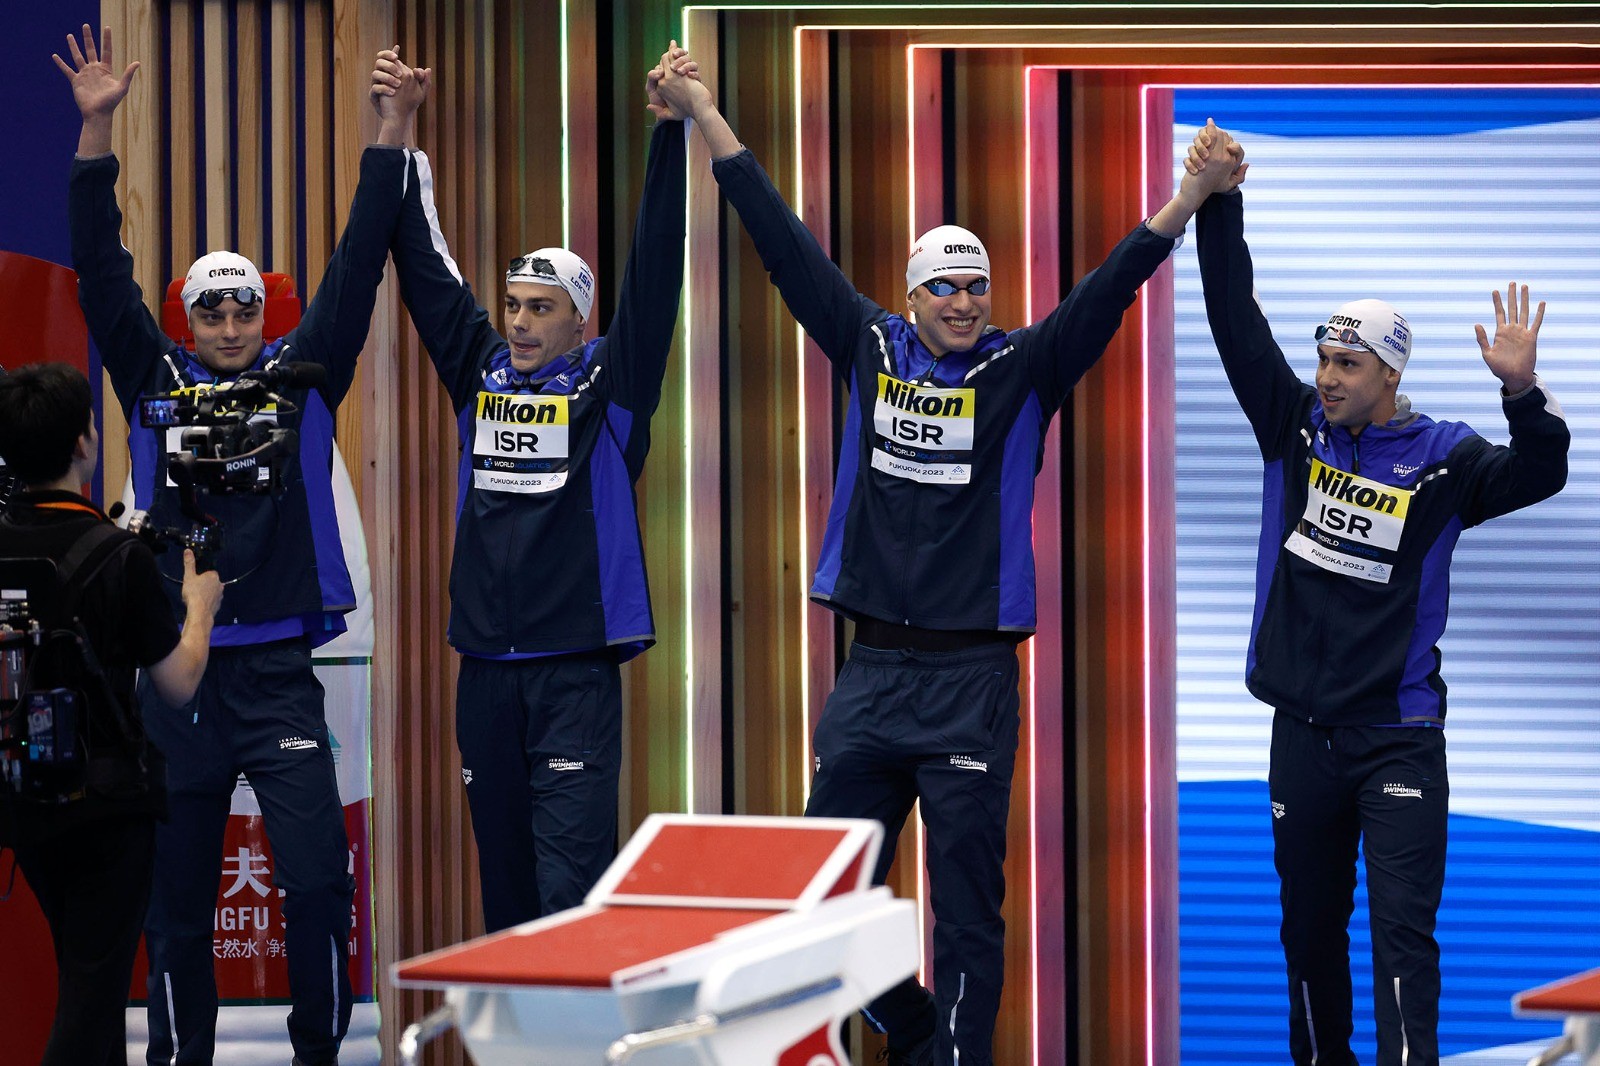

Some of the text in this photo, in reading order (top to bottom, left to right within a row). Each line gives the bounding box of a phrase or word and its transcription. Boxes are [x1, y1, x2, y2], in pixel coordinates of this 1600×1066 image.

[943, 244, 982, 256] arena
[208, 266, 247, 278] arena
[1328, 314, 1363, 329] arena
[1393, 327, 1408, 344] ISR
[884, 379, 964, 417] Nikon
[481, 395, 557, 424] Nikon
[892, 416, 944, 446] ISR
[494, 430, 539, 453] ISR
[226, 457, 256, 472] RONIN
[494, 460, 515, 469] WORLD
[888, 461, 921, 475] FUKUOKA
[490, 477, 519, 486] FUKUOKA
[1314, 465, 1399, 515] Nikon
[1319, 503, 1373, 539] ISR
[1311, 548, 1365, 571] FUKUOKA 2023
[280, 739, 318, 749] SWIMMING
[549, 761, 584, 769] SWIMMING
[950, 758, 988, 768] SWIMMING
[1383, 787, 1422, 795] SWIMMING
[214, 906, 269, 931] GFU
